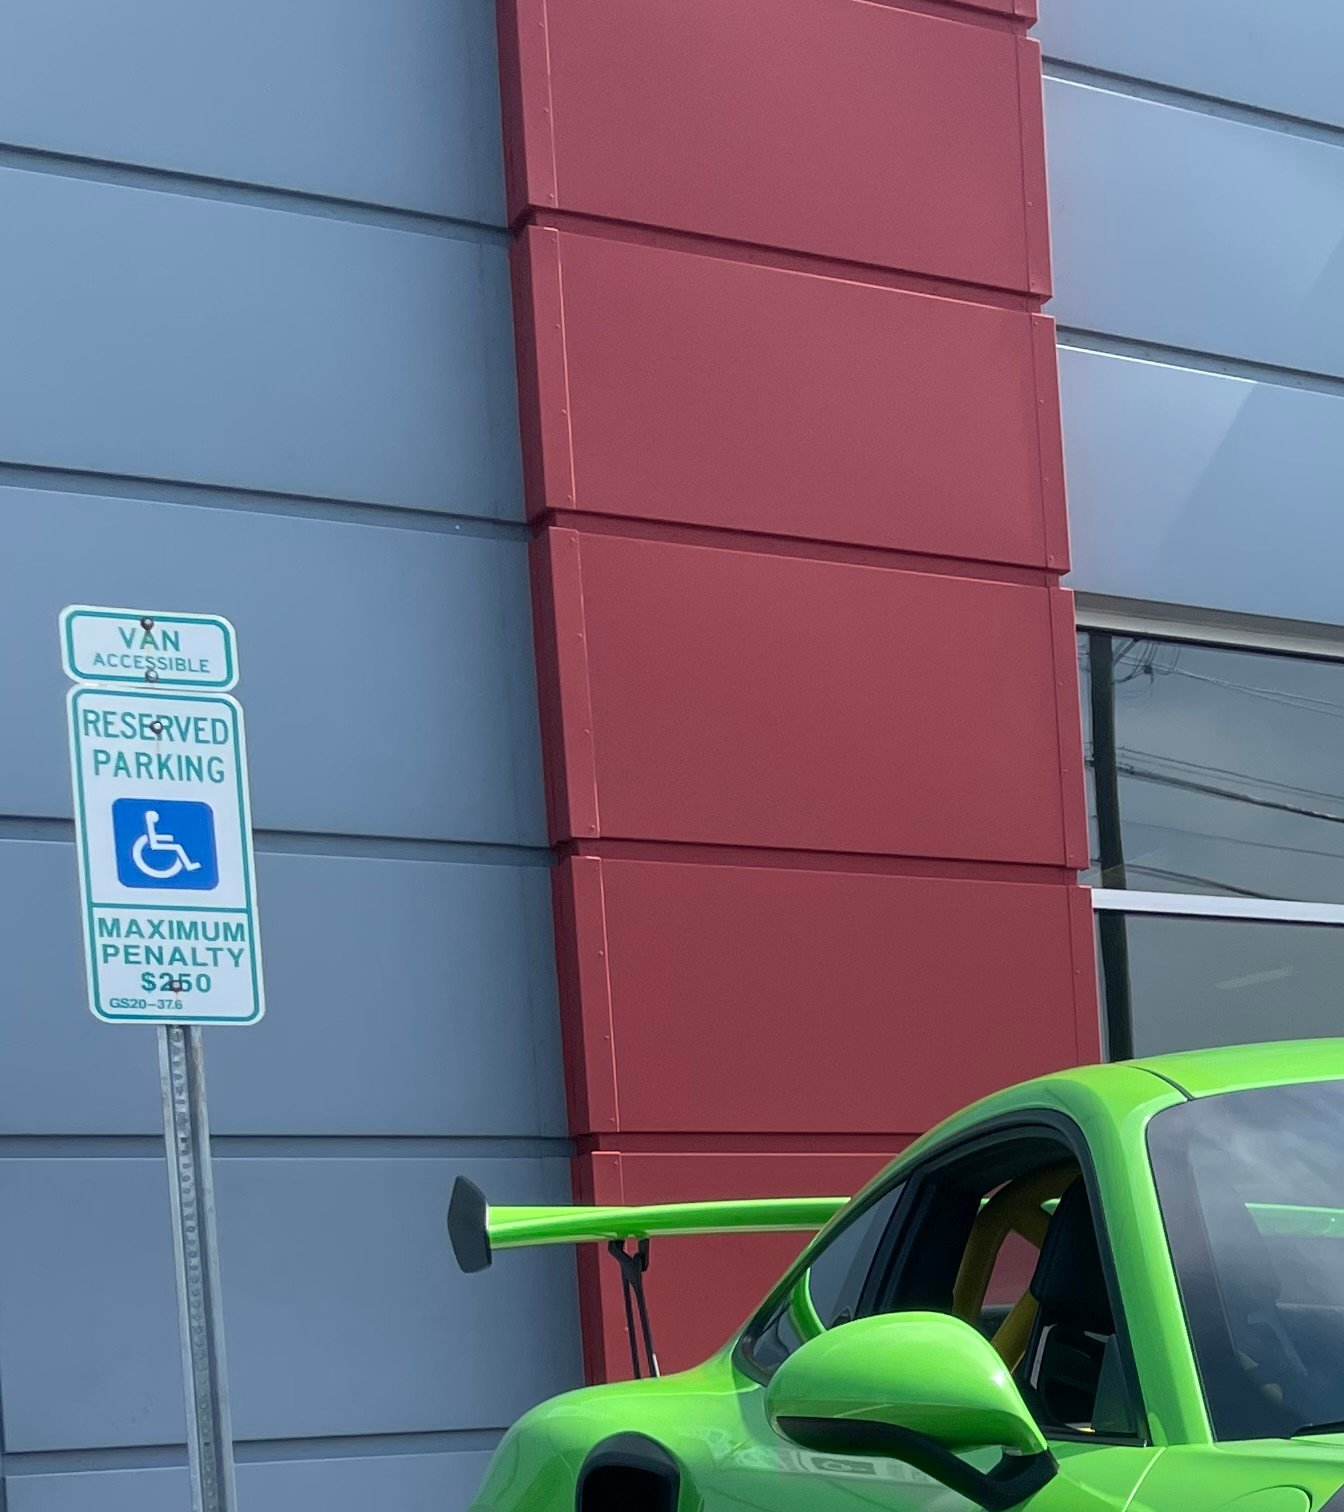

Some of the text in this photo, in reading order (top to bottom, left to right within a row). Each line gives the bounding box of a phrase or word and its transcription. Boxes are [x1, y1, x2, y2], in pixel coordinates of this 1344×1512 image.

[118, 626, 181, 653] VAN
[93, 653, 211, 674] ACCESSIBLE
[84, 709, 229, 745] RESERVED
[93, 749, 226, 784] PARKING
[98, 917, 247, 943] MAXIMUM
[102, 944, 246, 968] PENALTY
[141, 971, 212, 993] $250
